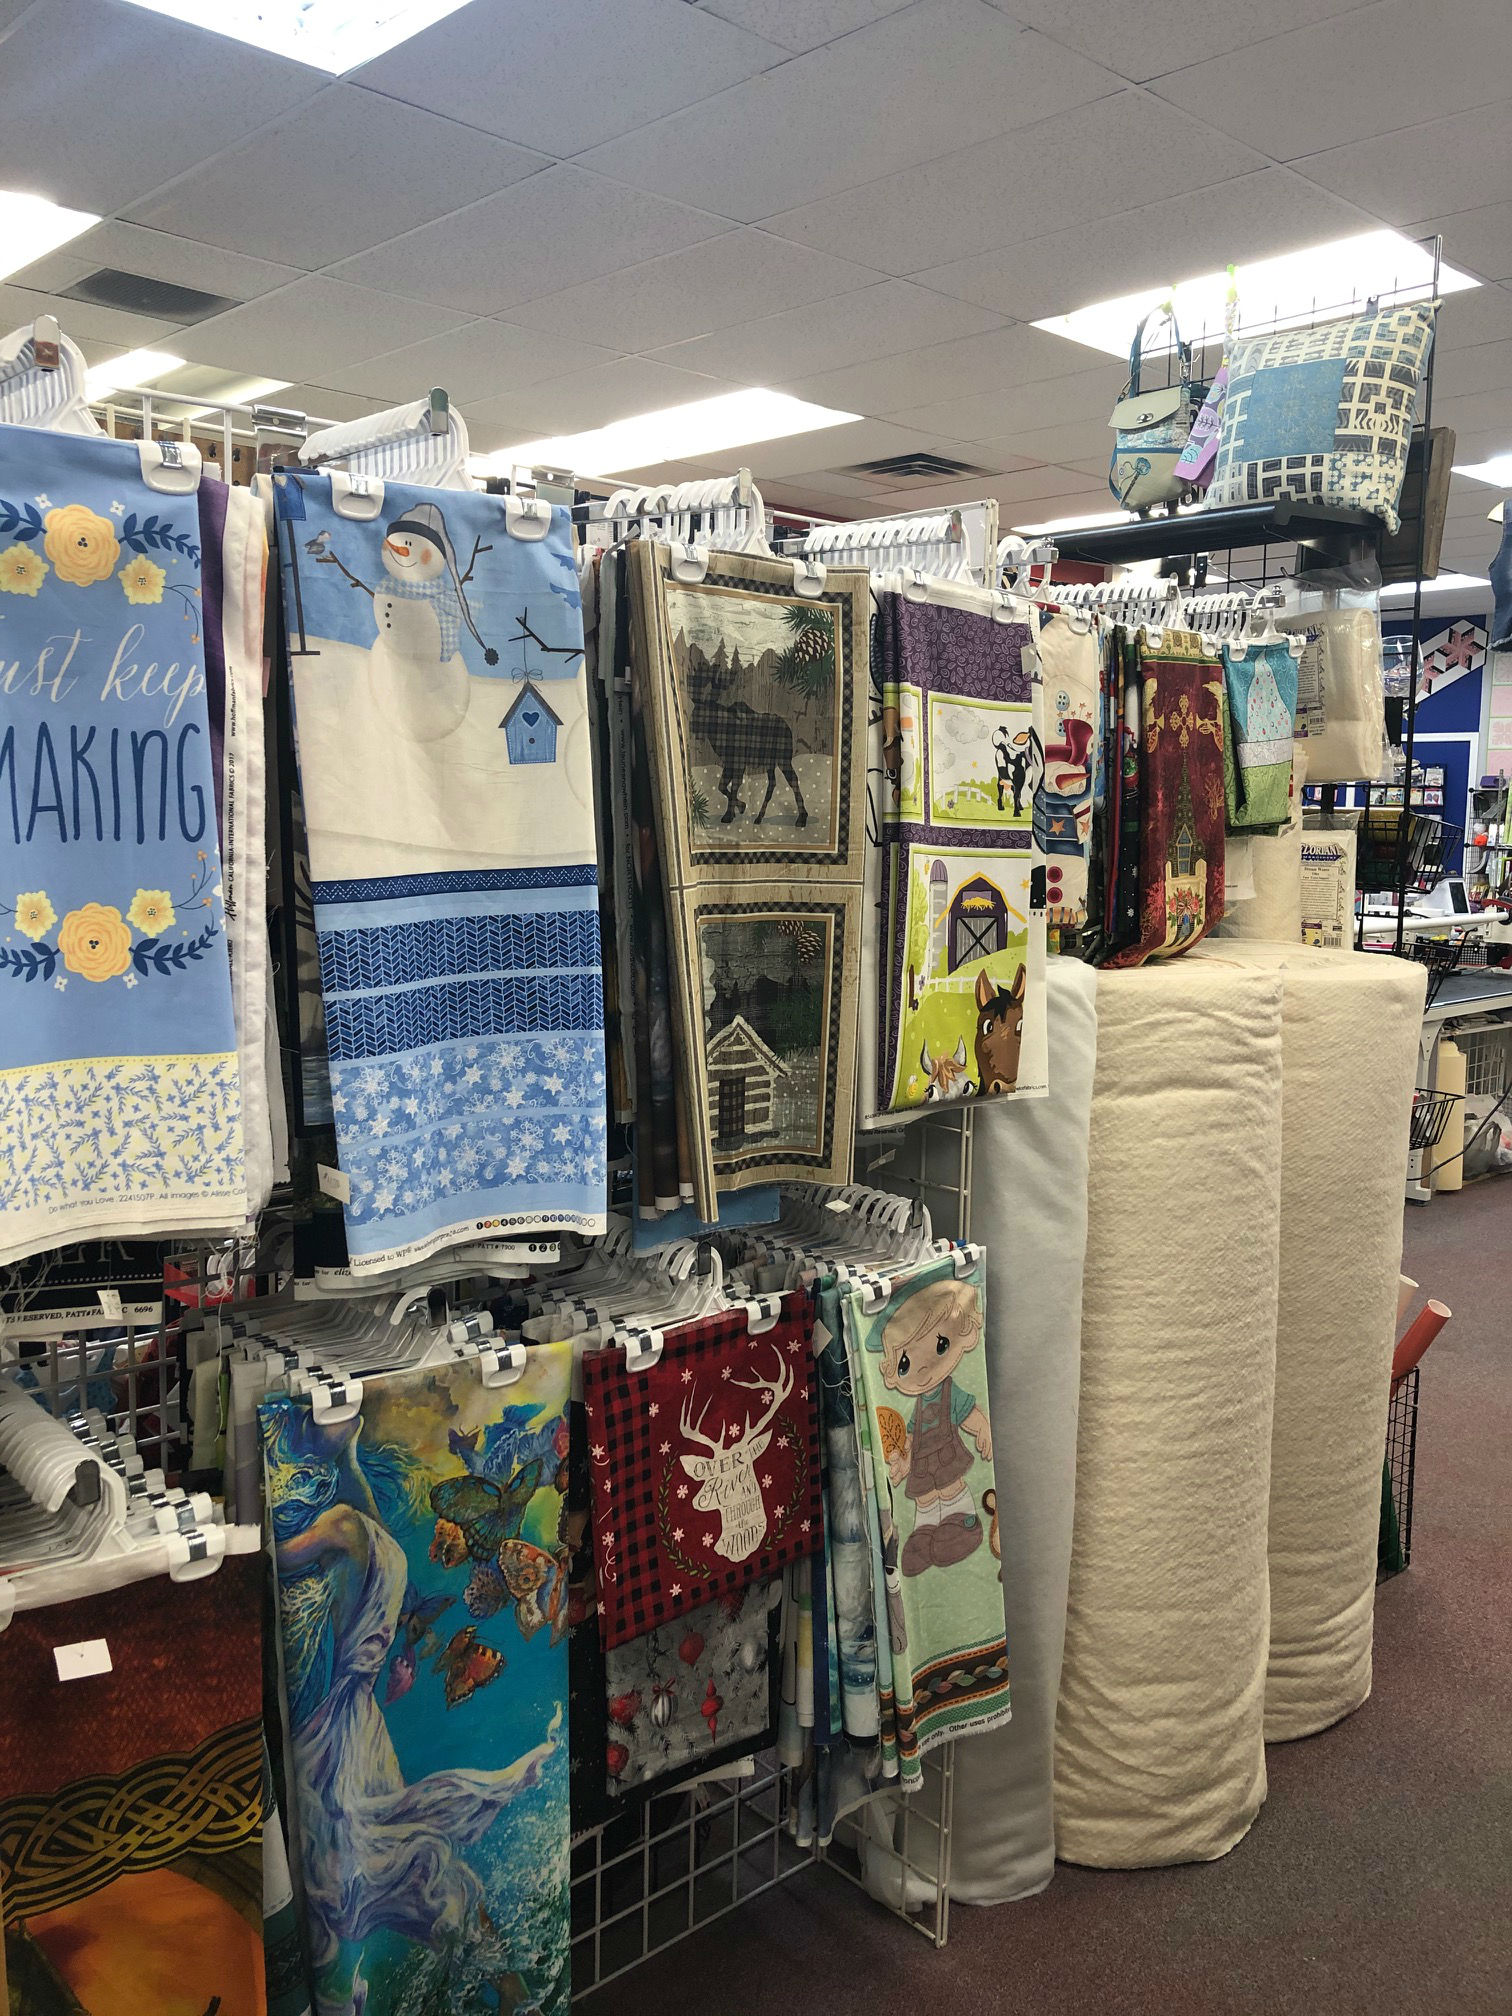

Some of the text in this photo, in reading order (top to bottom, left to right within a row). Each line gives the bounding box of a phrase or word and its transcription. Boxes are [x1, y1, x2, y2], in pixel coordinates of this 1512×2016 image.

[0, 623, 207, 728] ust keep
[134, 1306, 154, 1314] 6696
[693, 1451, 744, 1478] OVER
[948, 1722, 968, 1733] Other
[969, 1718, 985, 1728] uses
